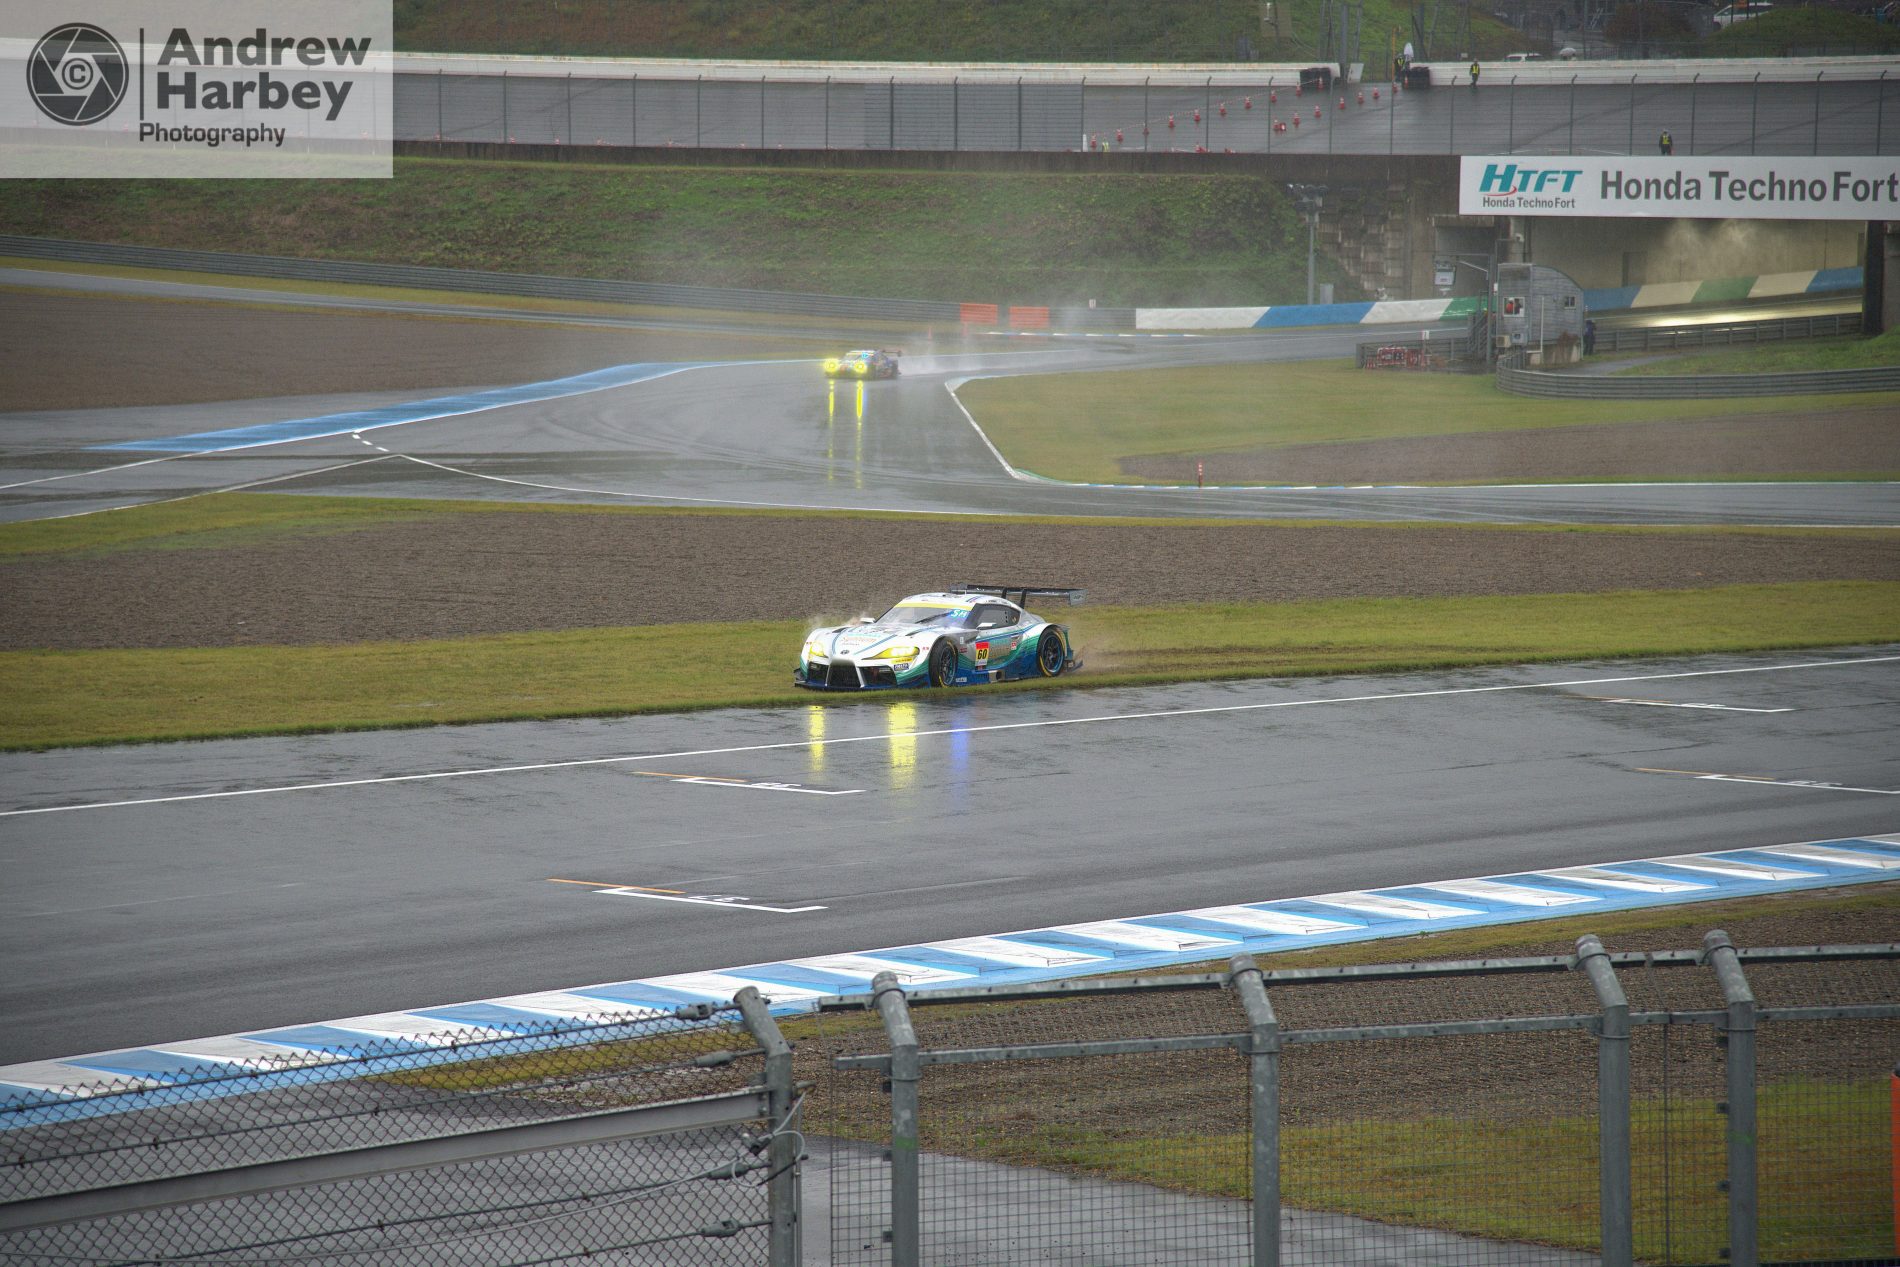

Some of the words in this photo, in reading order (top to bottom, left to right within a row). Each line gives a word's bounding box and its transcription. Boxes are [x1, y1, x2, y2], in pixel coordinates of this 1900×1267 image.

[1479, 164, 1584, 193] HTFT
[1600, 170, 1702, 201] Honda
[1482, 197, 1515, 208] Honda
[977, 648, 988, 660] 60
